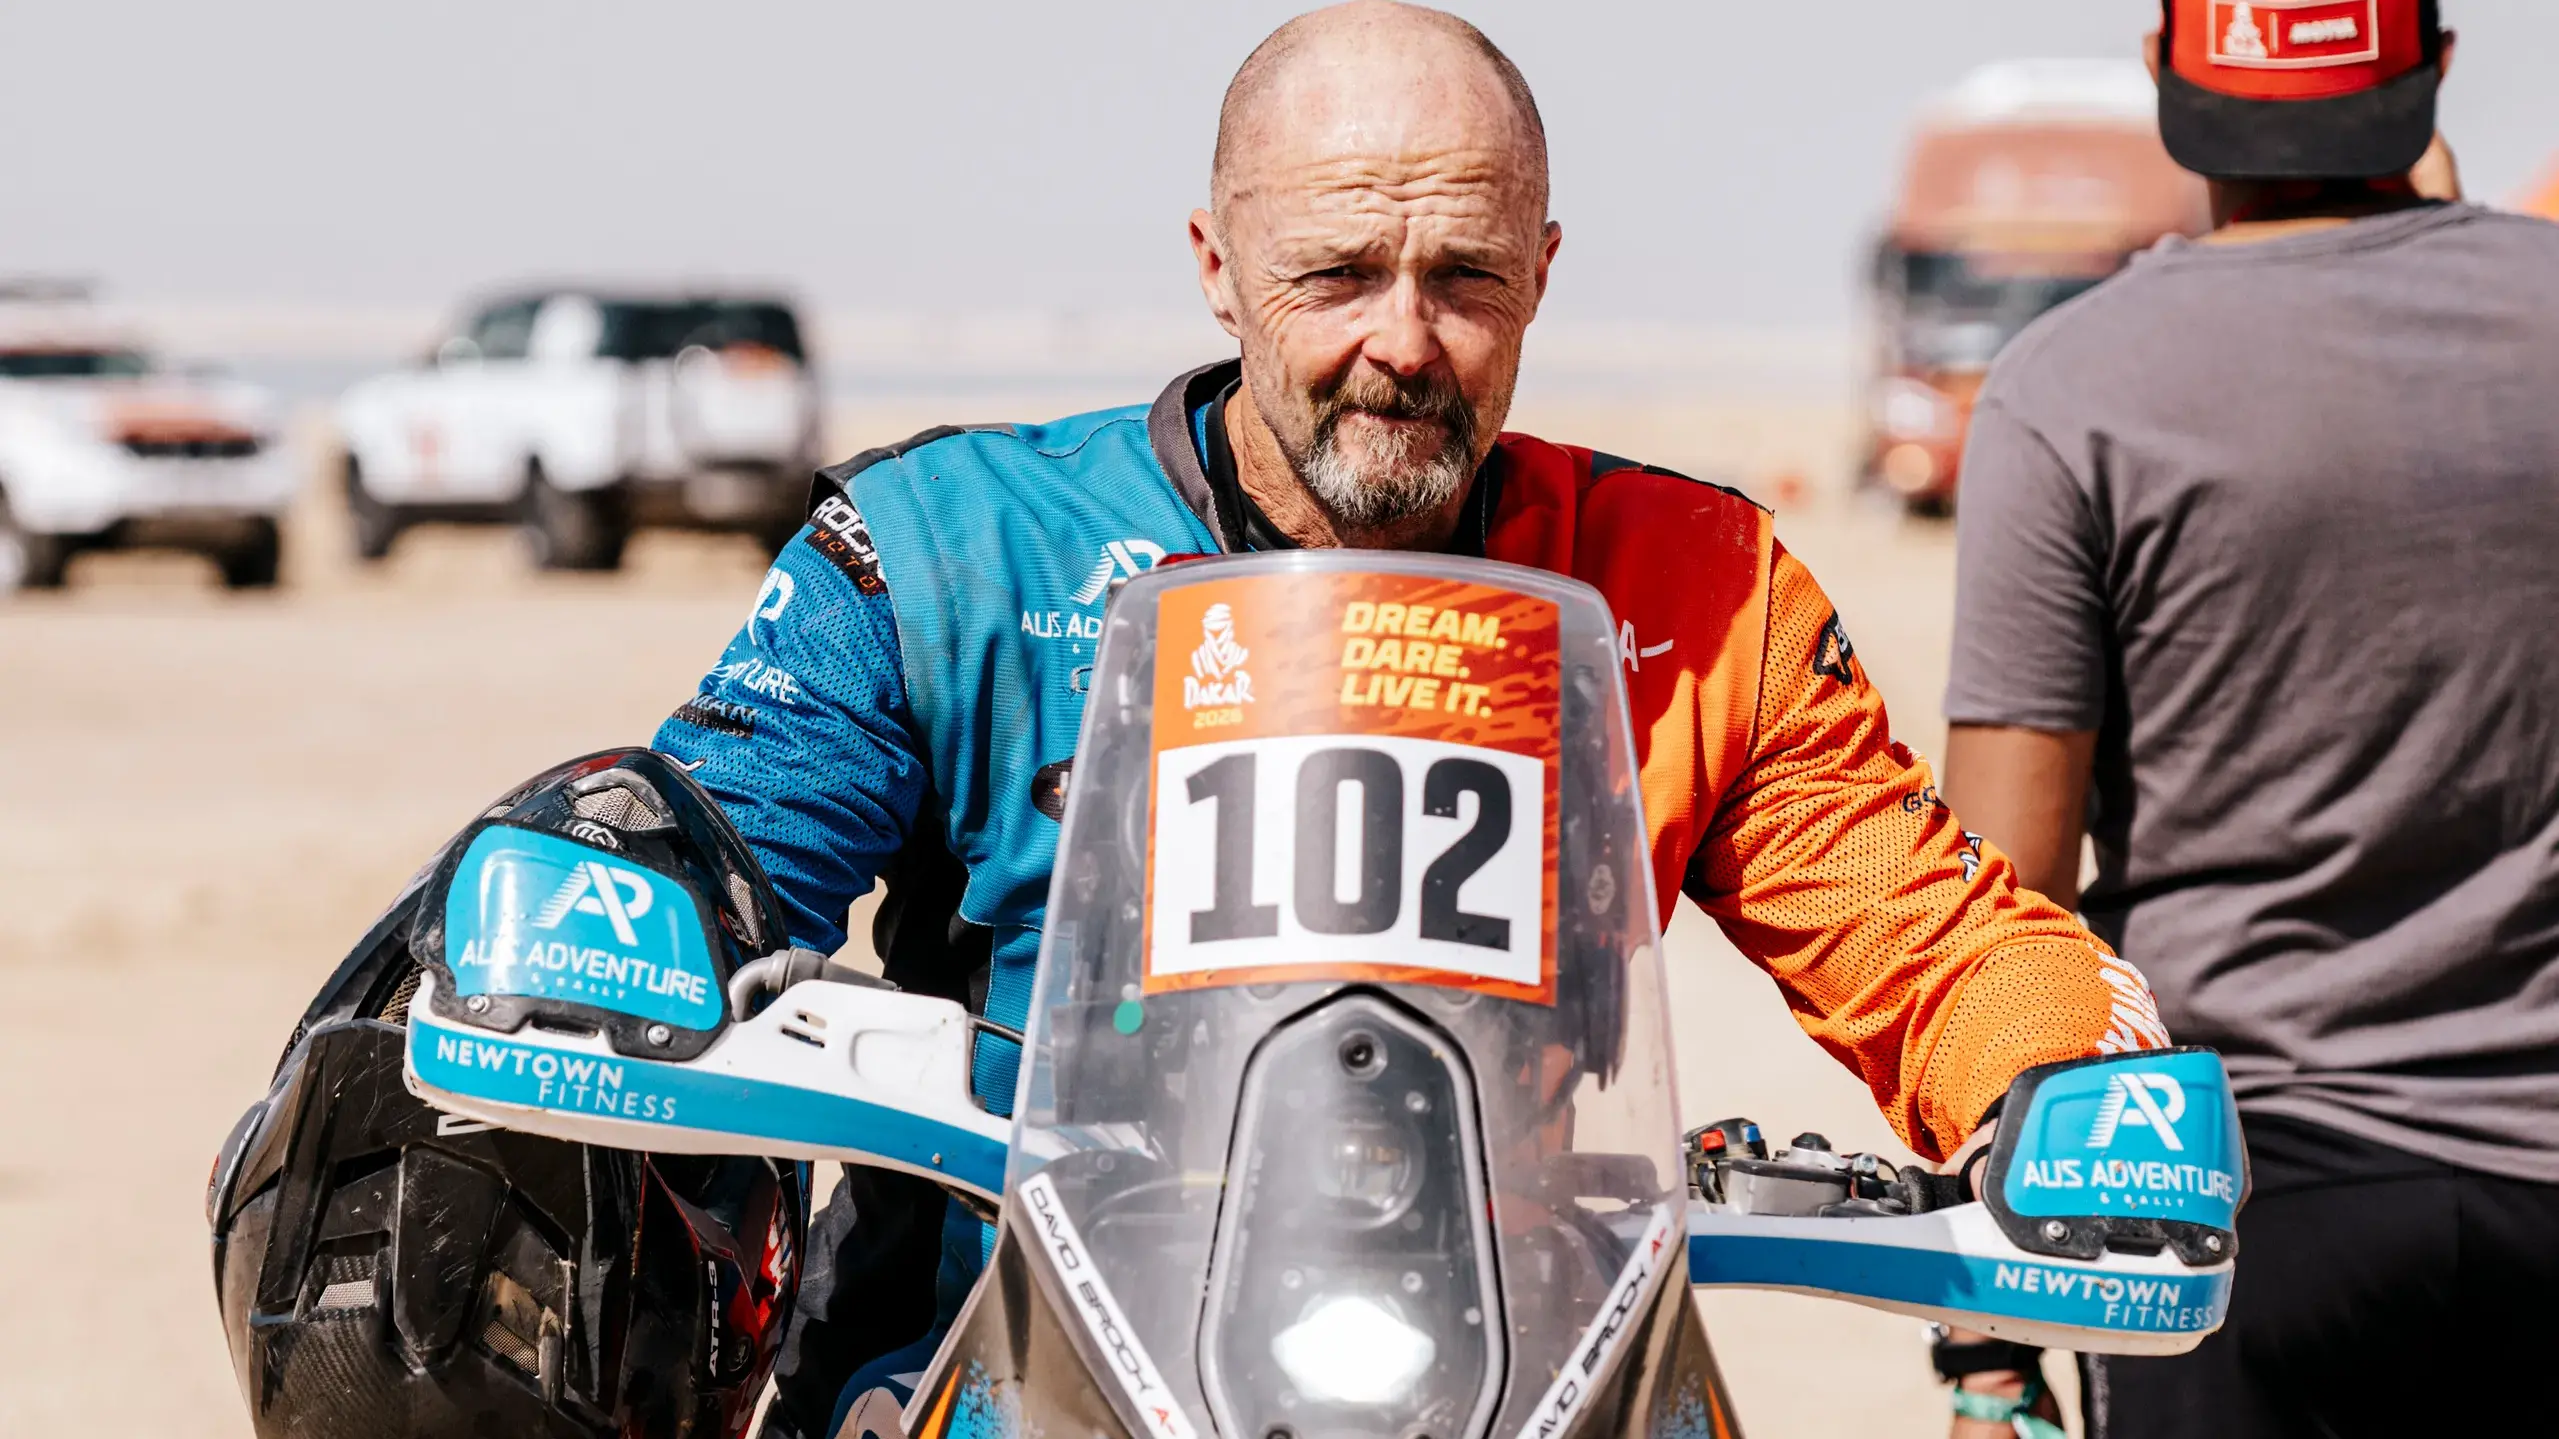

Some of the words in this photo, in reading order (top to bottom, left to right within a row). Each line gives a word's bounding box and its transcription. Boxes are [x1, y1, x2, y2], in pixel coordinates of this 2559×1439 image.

[1341, 602, 1508, 650] DREAM.
[1341, 638, 1472, 679] DARE.
[1183, 671, 1255, 710] DAKAR
[1340, 674, 1440, 711] LIVE
[1444, 682, 1494, 719] IT.
[1184, 746, 1513, 953] 102
[525, 940, 709, 1006] ADVENTURE
[436, 1034, 625, 1090] NEWTOWN
[537, 1080, 678, 1121] FITNESS
[2022, 1158, 2084, 1189] AUS
[2090, 1159, 2234, 1205] ADVENTURE
[1030, 1186, 1081, 1271] DAVID
[1993, 1263, 2182, 1308] NEWTOWN
[707, 1259, 720, 1379] ATR-3
[2103, 1304, 2215, 1329] FITNESS
[1530, 1380, 1580, 1439] AVID
